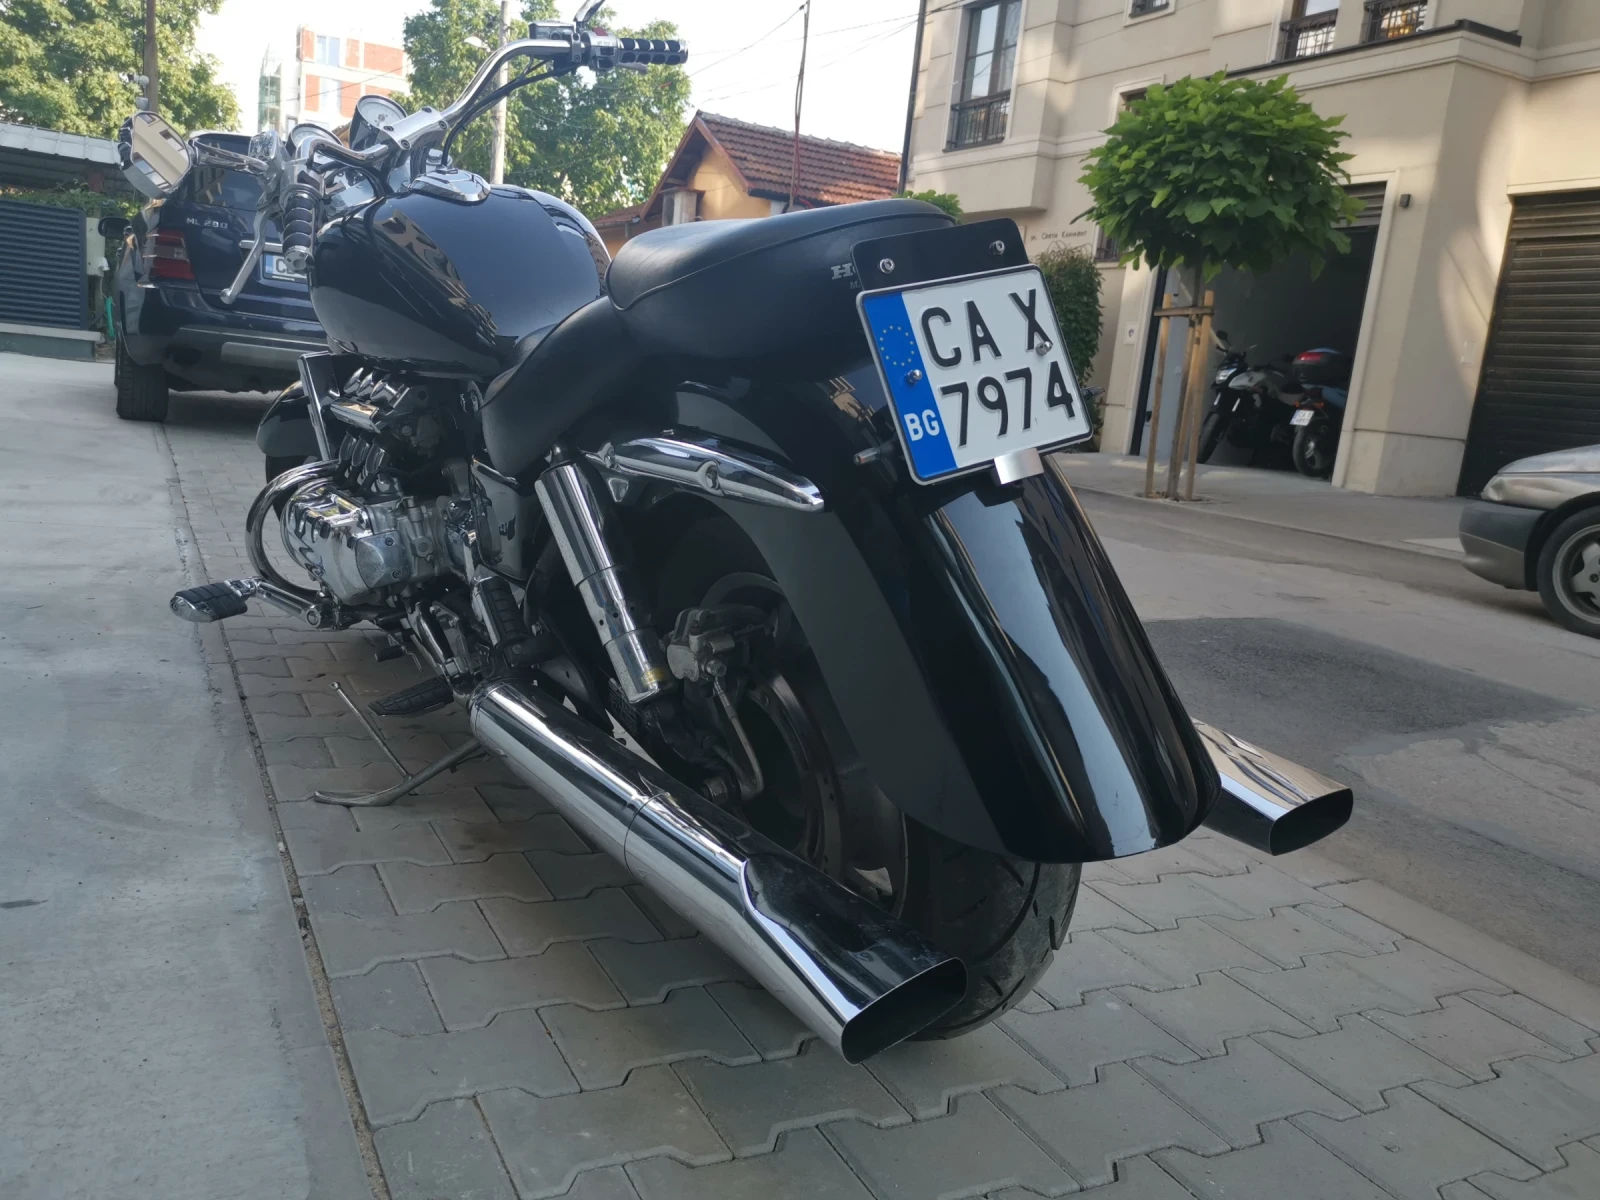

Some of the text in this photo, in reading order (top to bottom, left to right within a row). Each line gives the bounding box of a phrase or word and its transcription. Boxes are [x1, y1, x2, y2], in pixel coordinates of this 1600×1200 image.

[186, 217, 200, 226] ML
[921, 288, 1053, 368] CA X
[903, 409, 940, 442] BG
[939, 361, 1076, 448] 7974
